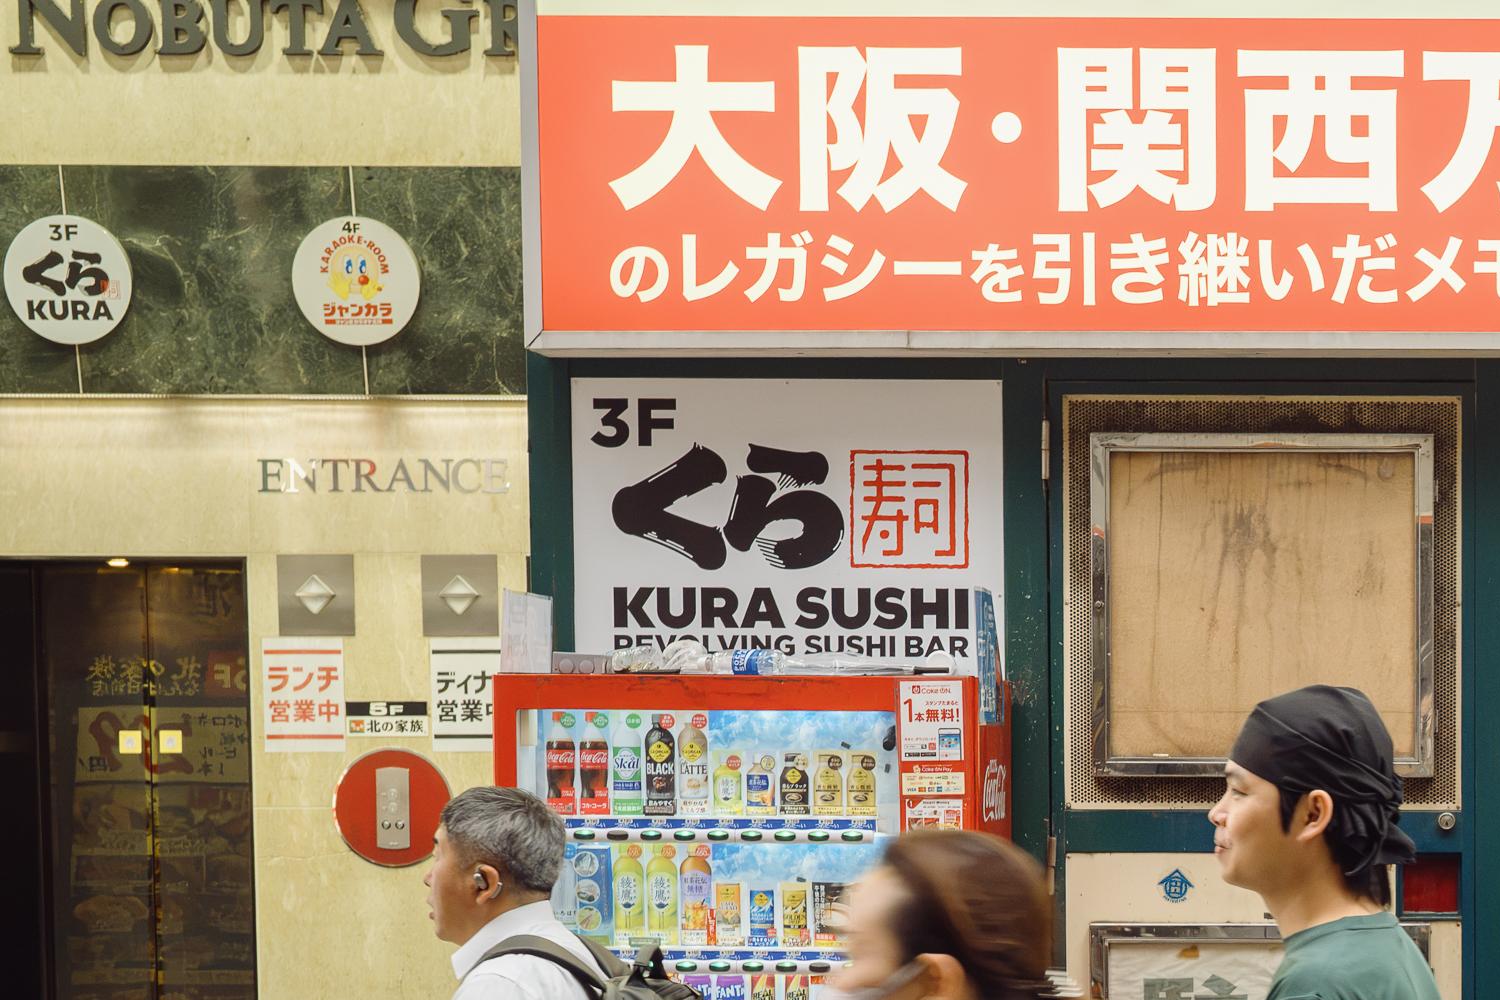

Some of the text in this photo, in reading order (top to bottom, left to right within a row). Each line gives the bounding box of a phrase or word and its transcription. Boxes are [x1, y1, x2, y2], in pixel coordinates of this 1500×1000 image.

[9, 0, 384, 57] NOBUTA
[49, 224, 78, 241] 3F
[342, 221, 360, 233] 4F
[22, 250, 110, 296] くら
[27, 300, 114, 320] KURA
[323, 303, 393, 317] ジャンカラ
[590, 398, 677, 447] 3F
[257, 458, 510, 494] ENTRANCE
[611, 442, 844, 570] くら
[613, 587, 969, 630] KURA SUSHI
[805, 635, 895, 657] SUSHI
[905, 635, 969, 657] BAR
[268, 667, 339, 692] ランチ
[269, 700, 339, 722] 営業中
[369, 703, 404, 715] 5F
[367, 719, 423, 732] 北の家族
[646, 763, 674, 775] BLACK
[680, 764, 708, 775] LATTE
[753, 989, 773, 1000] REAL
[786, 989, 806, 1000] REAL
